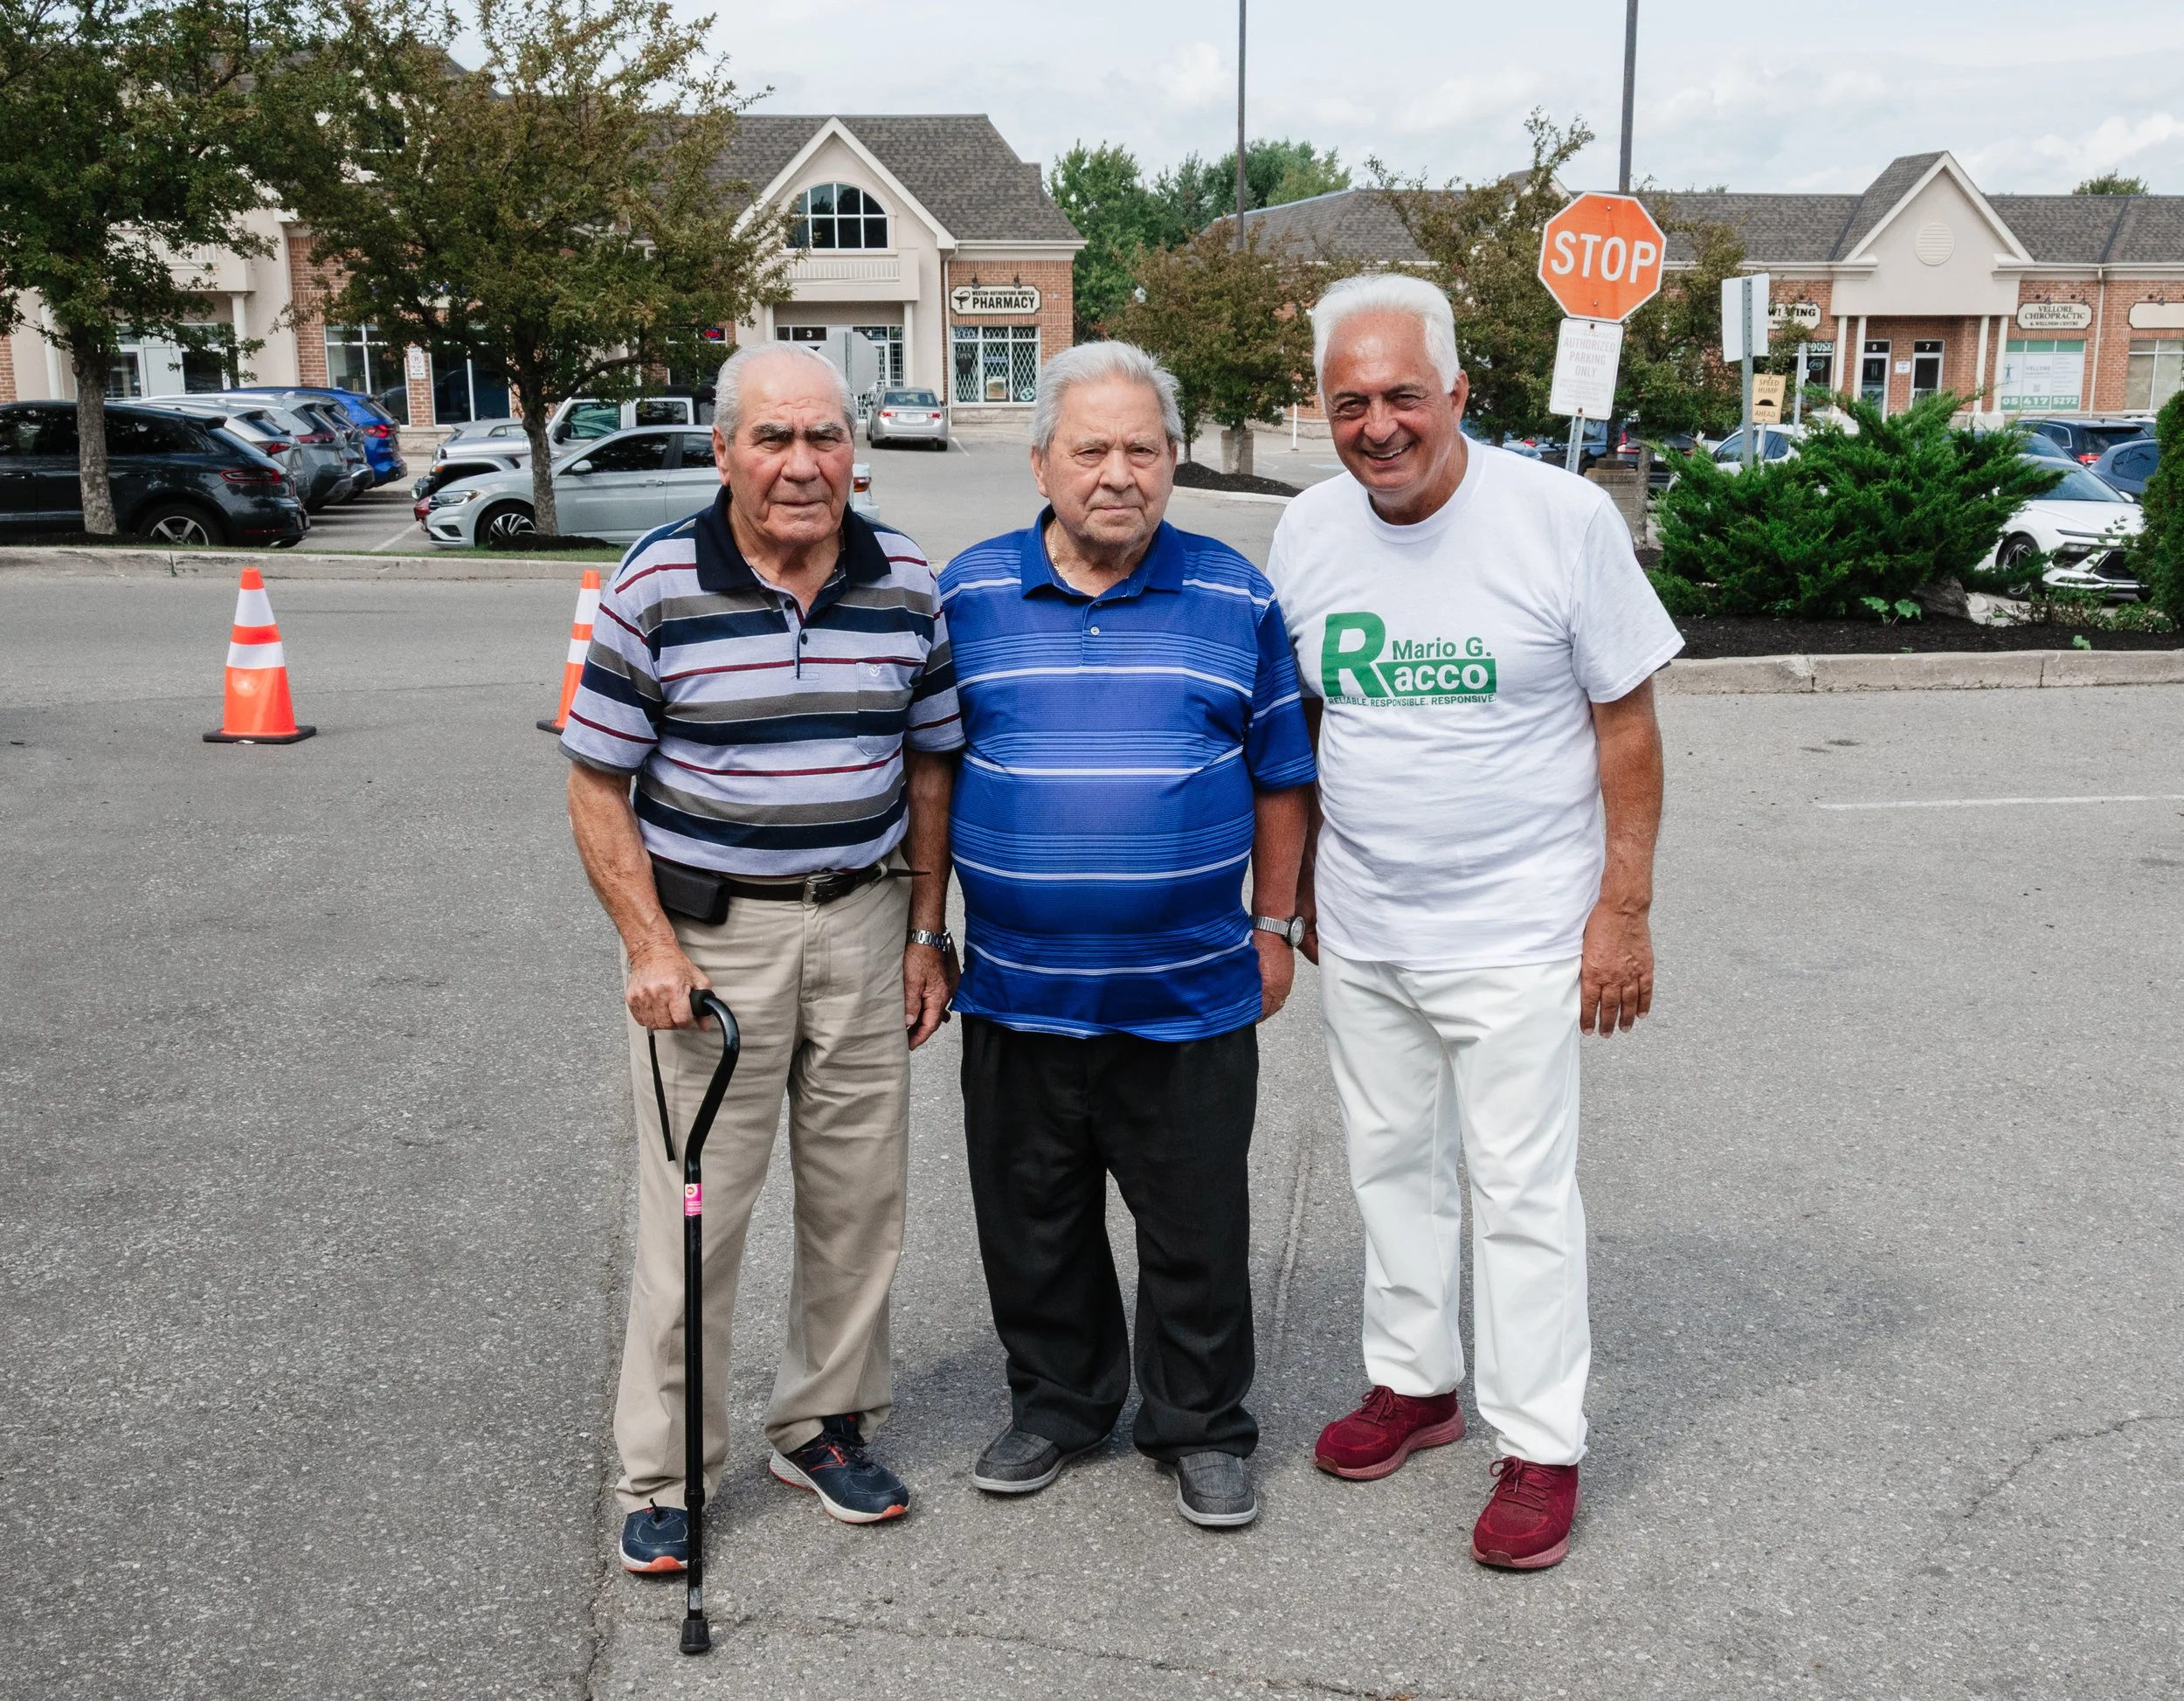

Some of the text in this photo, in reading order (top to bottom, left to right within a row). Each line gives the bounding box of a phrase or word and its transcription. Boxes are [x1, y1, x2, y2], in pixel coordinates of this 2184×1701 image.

[1551, 231, 1657, 284] STOP
[972, 297, 1035, 308] PHARMACY
[1563, 336, 1616, 352] AUTHORIZED
[1570, 351, 1607, 365] PARKING
[1575, 365, 1597, 377] ONLY
[1393, 636, 1492, 660] Mario G.
[1329, 694, 1497, 708] RELIABLE. RESPONSIBLE. RESPONSIVE.
